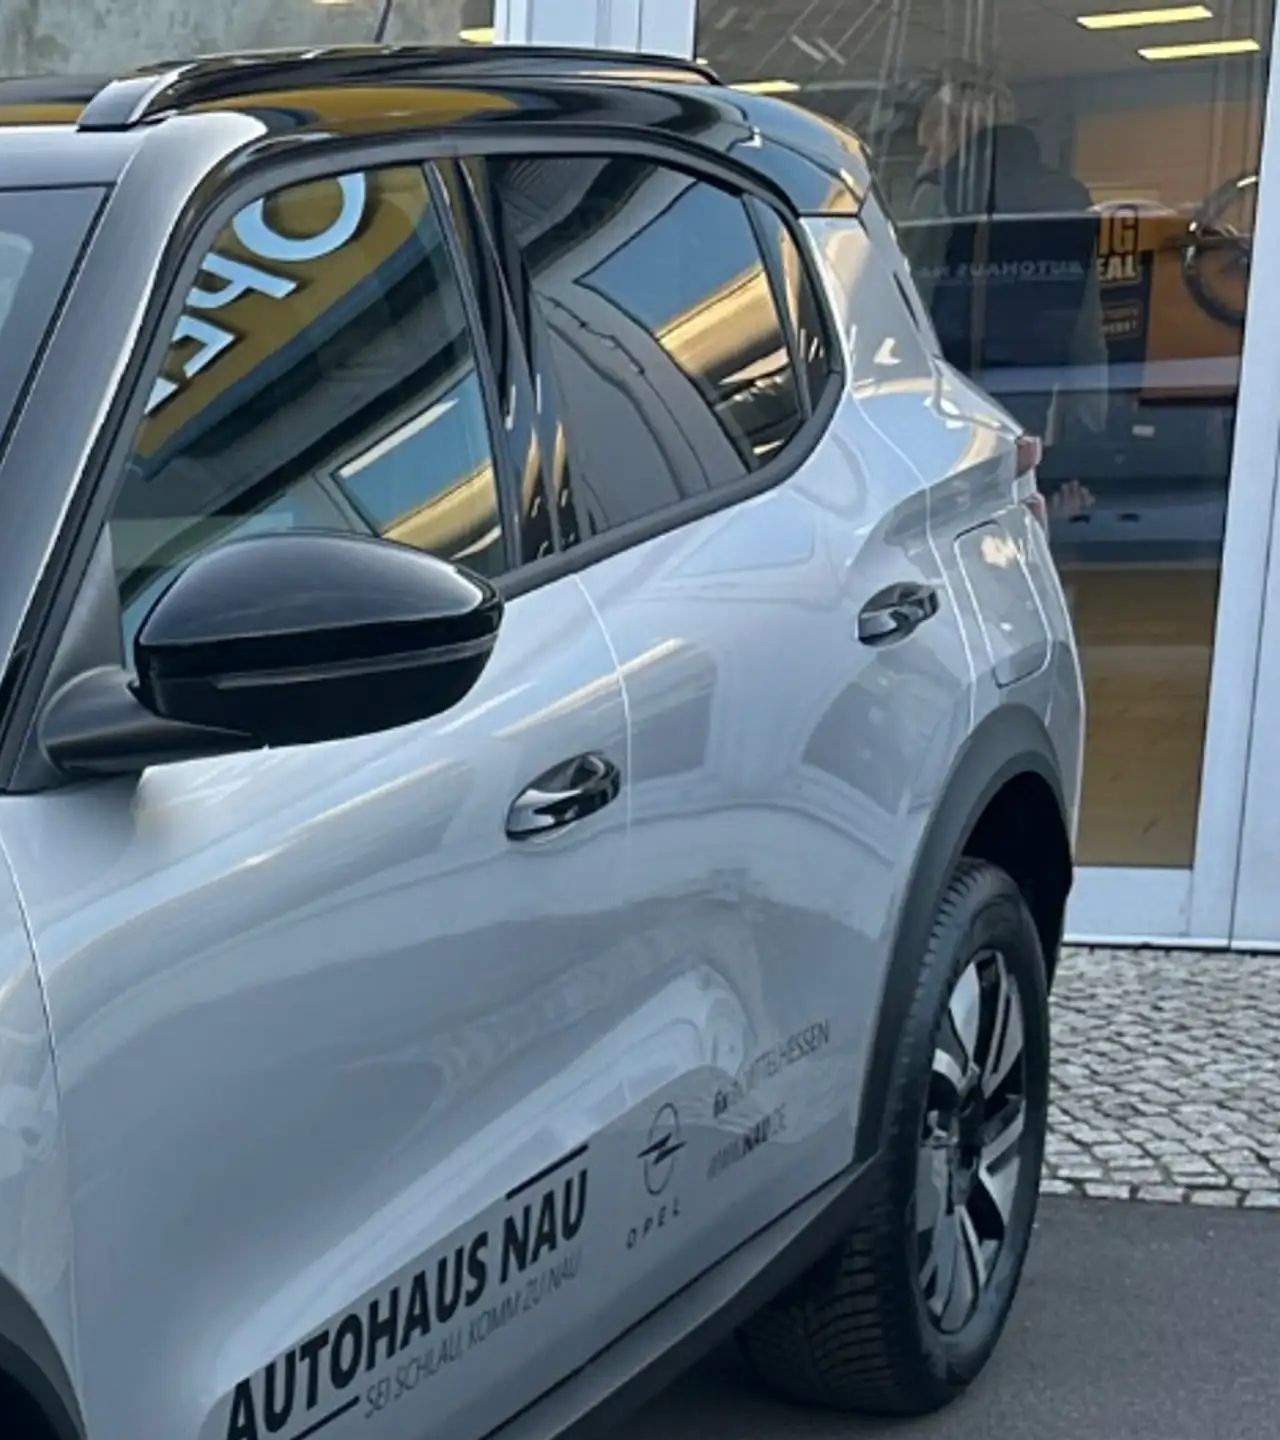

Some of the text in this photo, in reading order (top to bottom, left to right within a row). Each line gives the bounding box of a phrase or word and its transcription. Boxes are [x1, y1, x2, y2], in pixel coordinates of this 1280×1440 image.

[1097, 254, 1137, 281] EAL
[499, 1169, 588, 1284] NAU
[626, 1196, 680, 1249] OPEL
